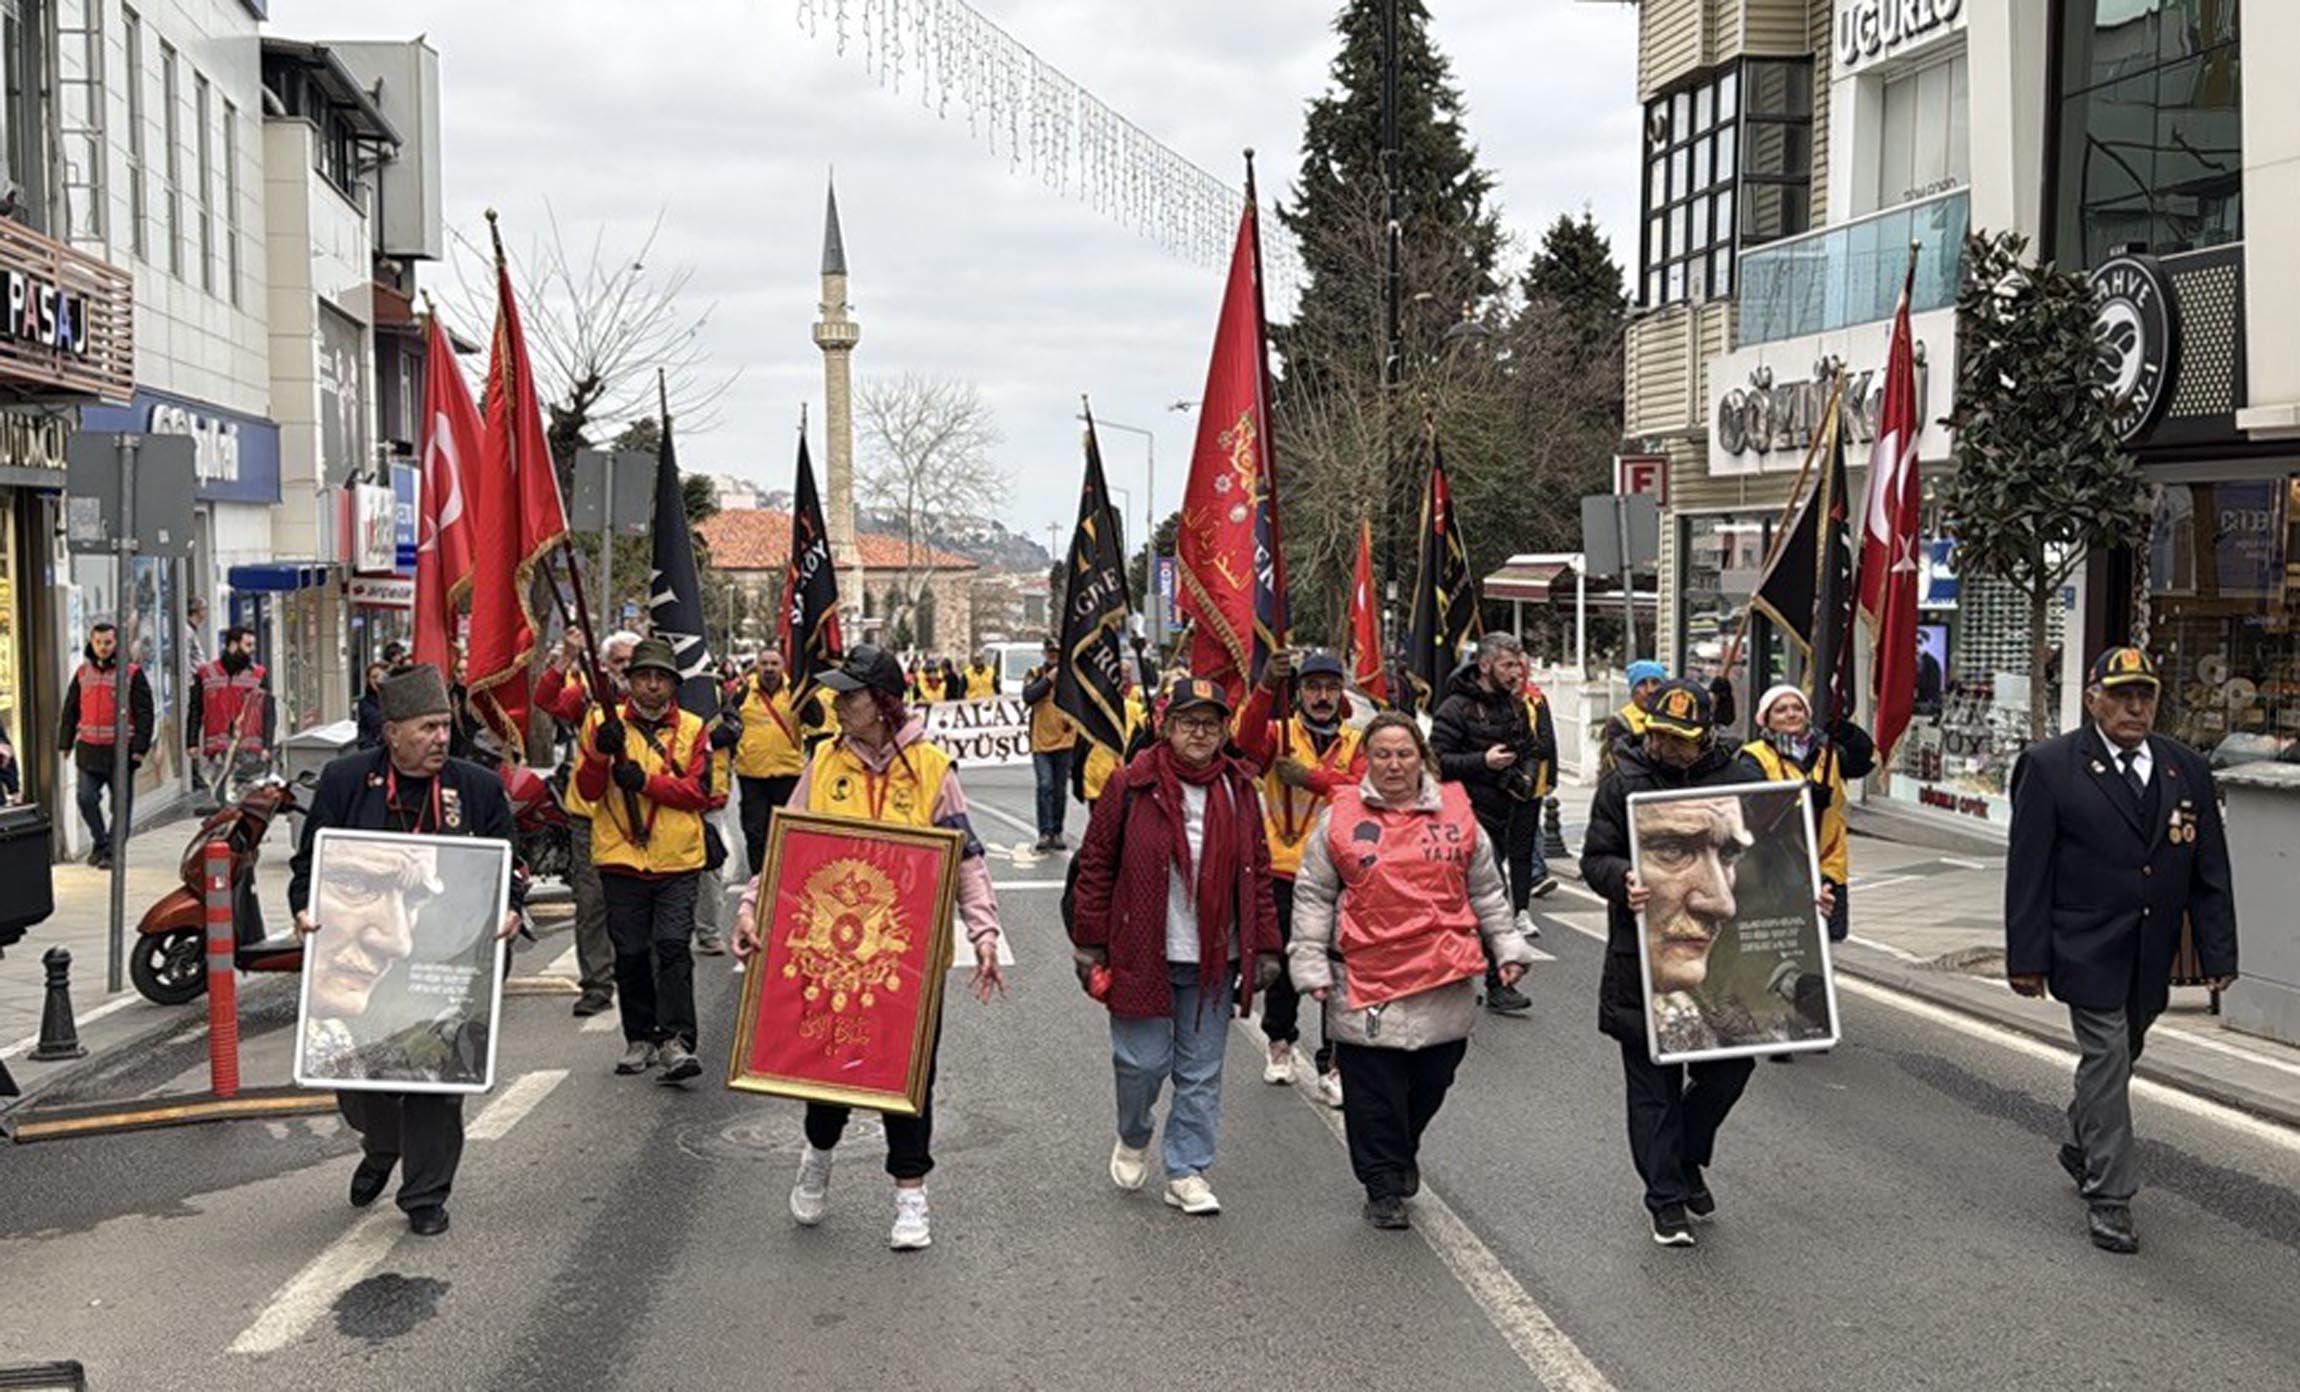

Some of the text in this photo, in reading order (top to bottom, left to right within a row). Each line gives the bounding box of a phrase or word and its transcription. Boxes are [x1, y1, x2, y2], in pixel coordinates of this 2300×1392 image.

[2094, 269, 2152, 308] AHVE
[8, 269, 88, 355] PASAJ
[952, 700, 1032, 729] ALAY
